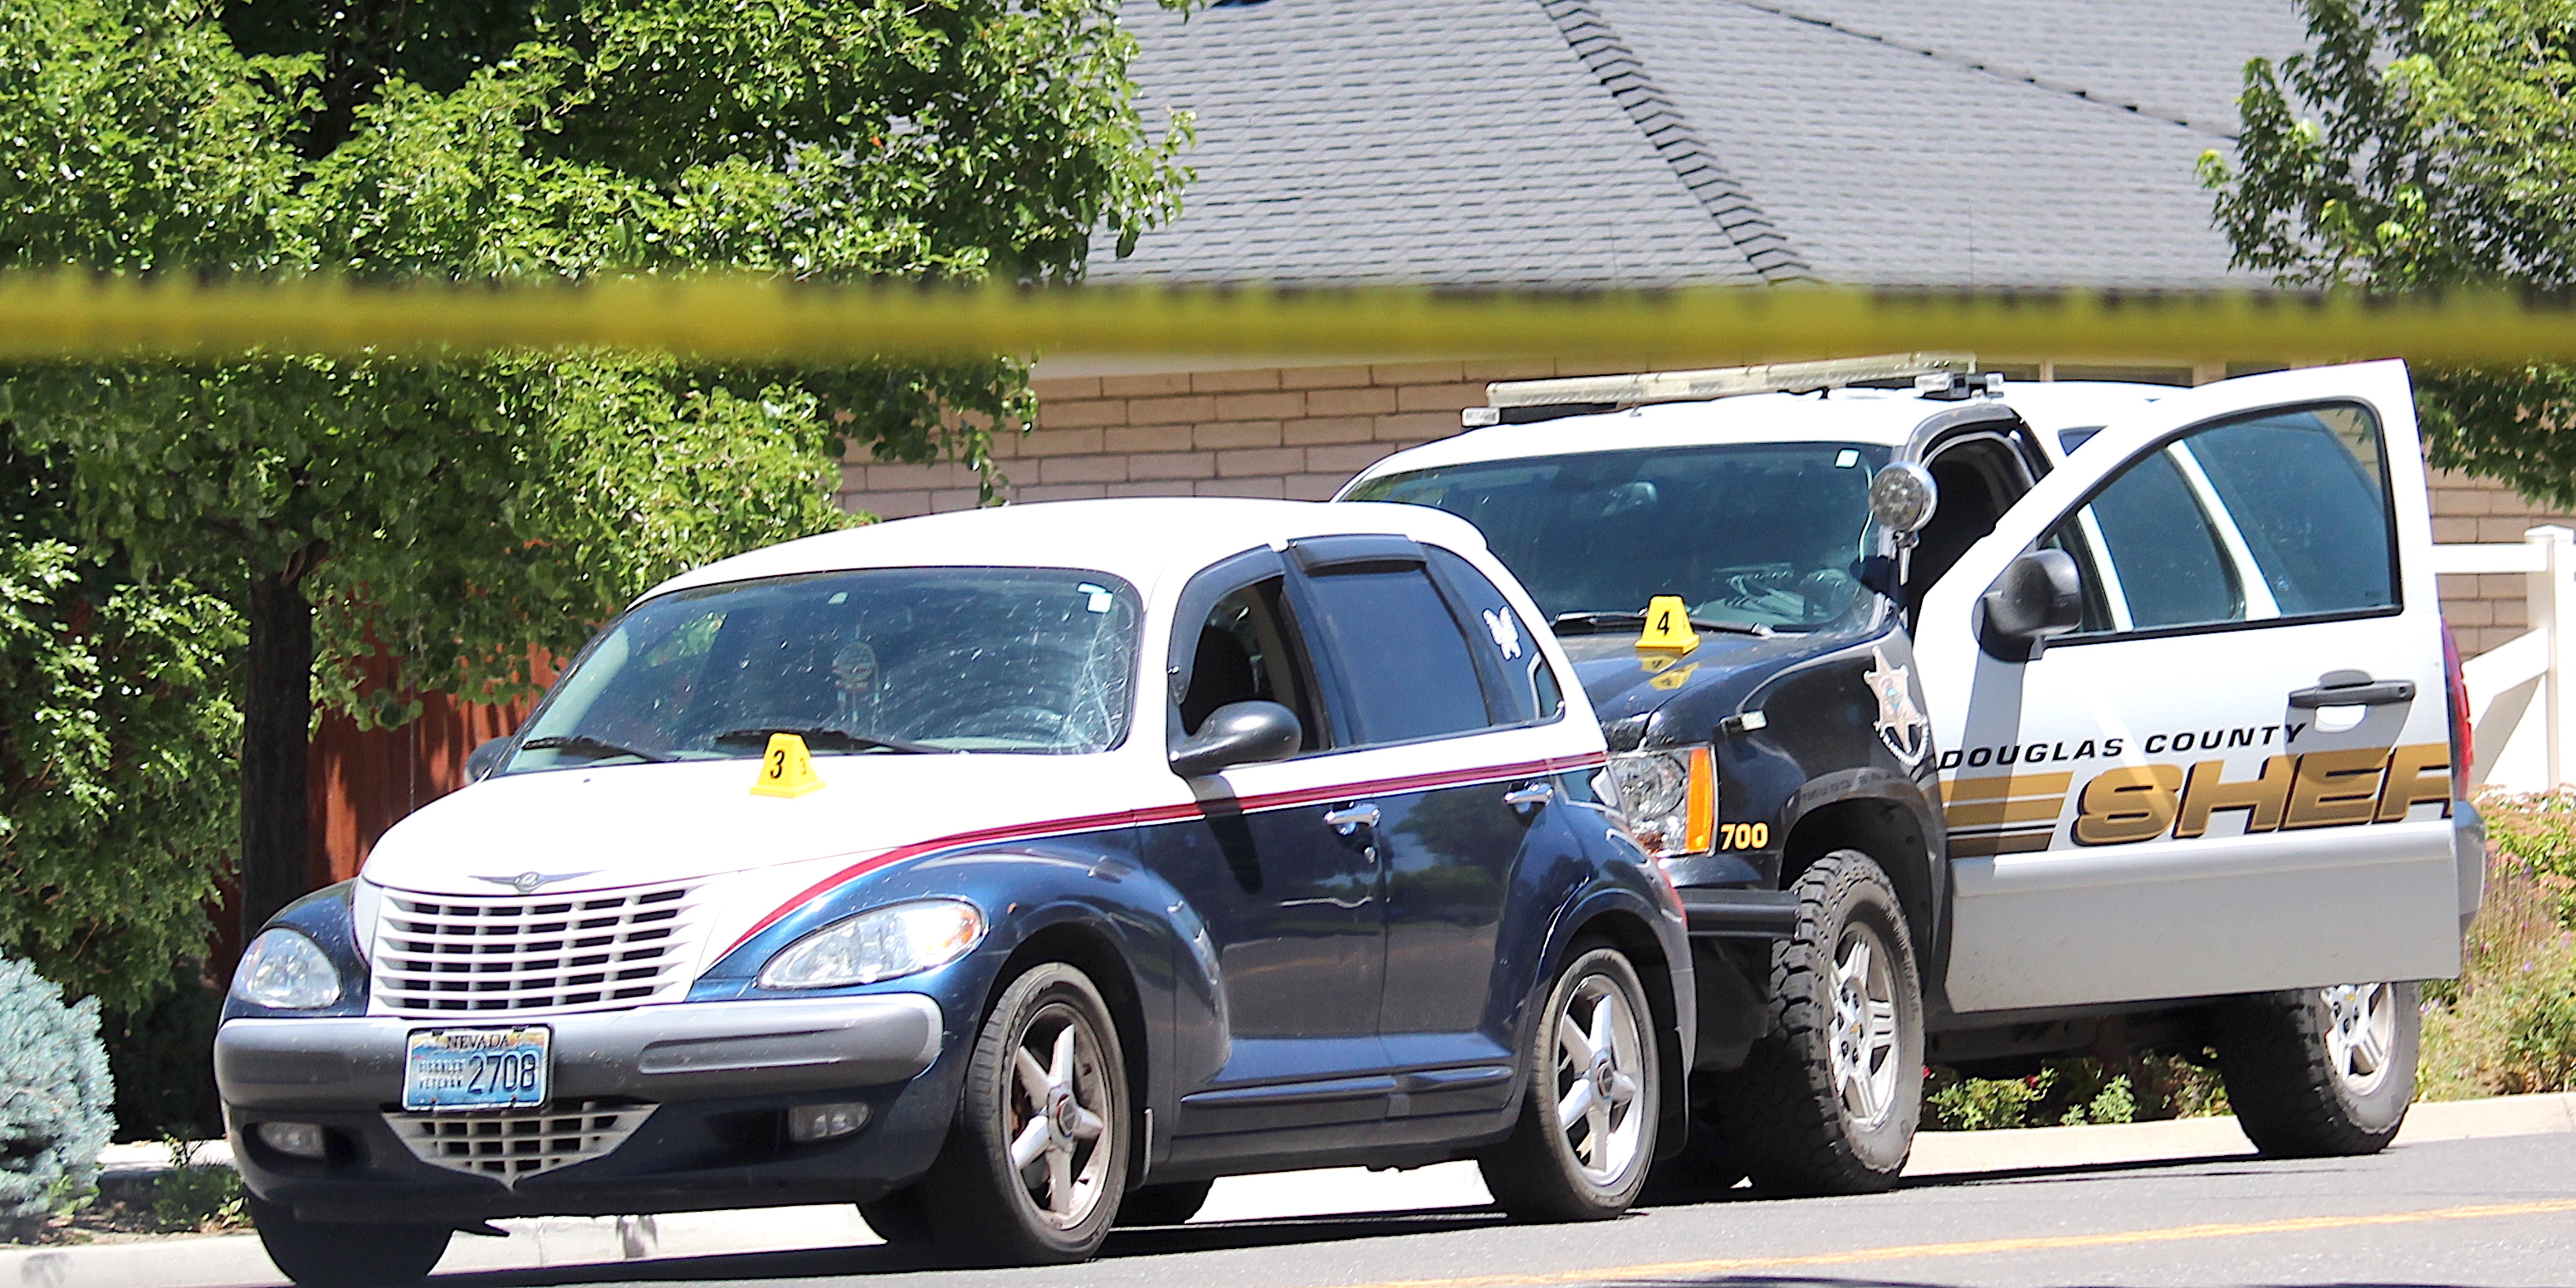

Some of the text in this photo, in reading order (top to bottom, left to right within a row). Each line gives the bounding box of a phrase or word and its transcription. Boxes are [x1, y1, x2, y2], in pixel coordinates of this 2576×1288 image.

[1656, 610, 1670, 637] 4
[1938, 722, 2306, 770] DOUGLAS COUNTY
[770, 749, 785, 779] 3
[1720, 822, 1769, 851] 700
[447, 1032, 510, 1049] NEVADA
[467, 1051, 538, 1095] 2708
